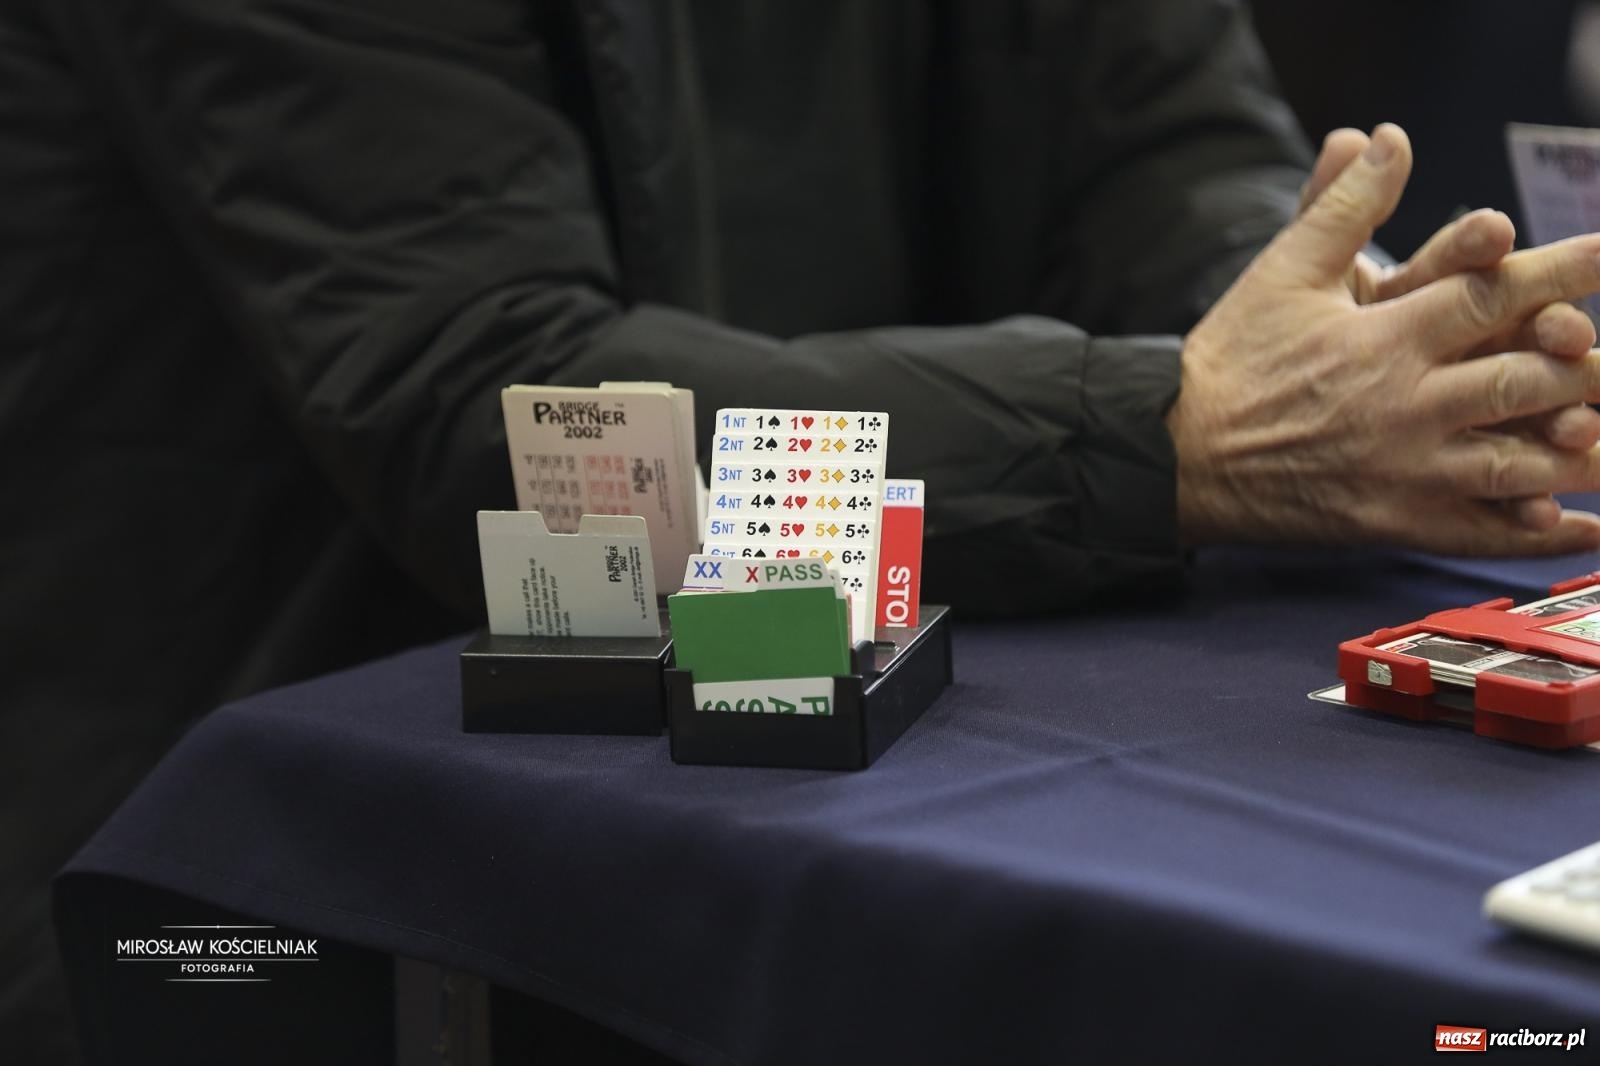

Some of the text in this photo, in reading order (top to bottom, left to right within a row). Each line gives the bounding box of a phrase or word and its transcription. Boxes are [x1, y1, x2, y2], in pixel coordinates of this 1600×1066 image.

[533, 402, 627, 426] PARTNER
[756, 416, 763, 429] 1
[790, 416, 798, 430] 1
[823, 417, 831, 430] 1
[857, 417, 865, 430] 1
[564, 426, 603, 439] 2002
[753, 437, 763, 450] 2
[788, 438, 798, 451] 2
[820, 438, 830, 452] 2
[854, 439, 865, 452] 2
[752, 468, 762, 482] 3
[787, 469, 797, 483] 3
[819, 469, 829, 483] 3
[850, 469, 860, 483] 3
[882, 486, 917, 501] ERT
[751, 494, 760, 508] 4
[783, 496, 793, 509] 4
[815, 496, 825, 509] 4
[847, 496, 857, 510] 4
[746, 522, 756, 535] 5
[780, 523, 790, 536] 5
[815, 523, 825, 537] 5
[845, 524, 855, 538] 5
[608, 545, 622, 583] PARTNER
[842, 550, 852, 564] 6
[694, 561, 722, 579] XX
[745, 566, 759, 583] X
[765, 563, 823, 583] PASS
[885, 565, 911, 628] STO
